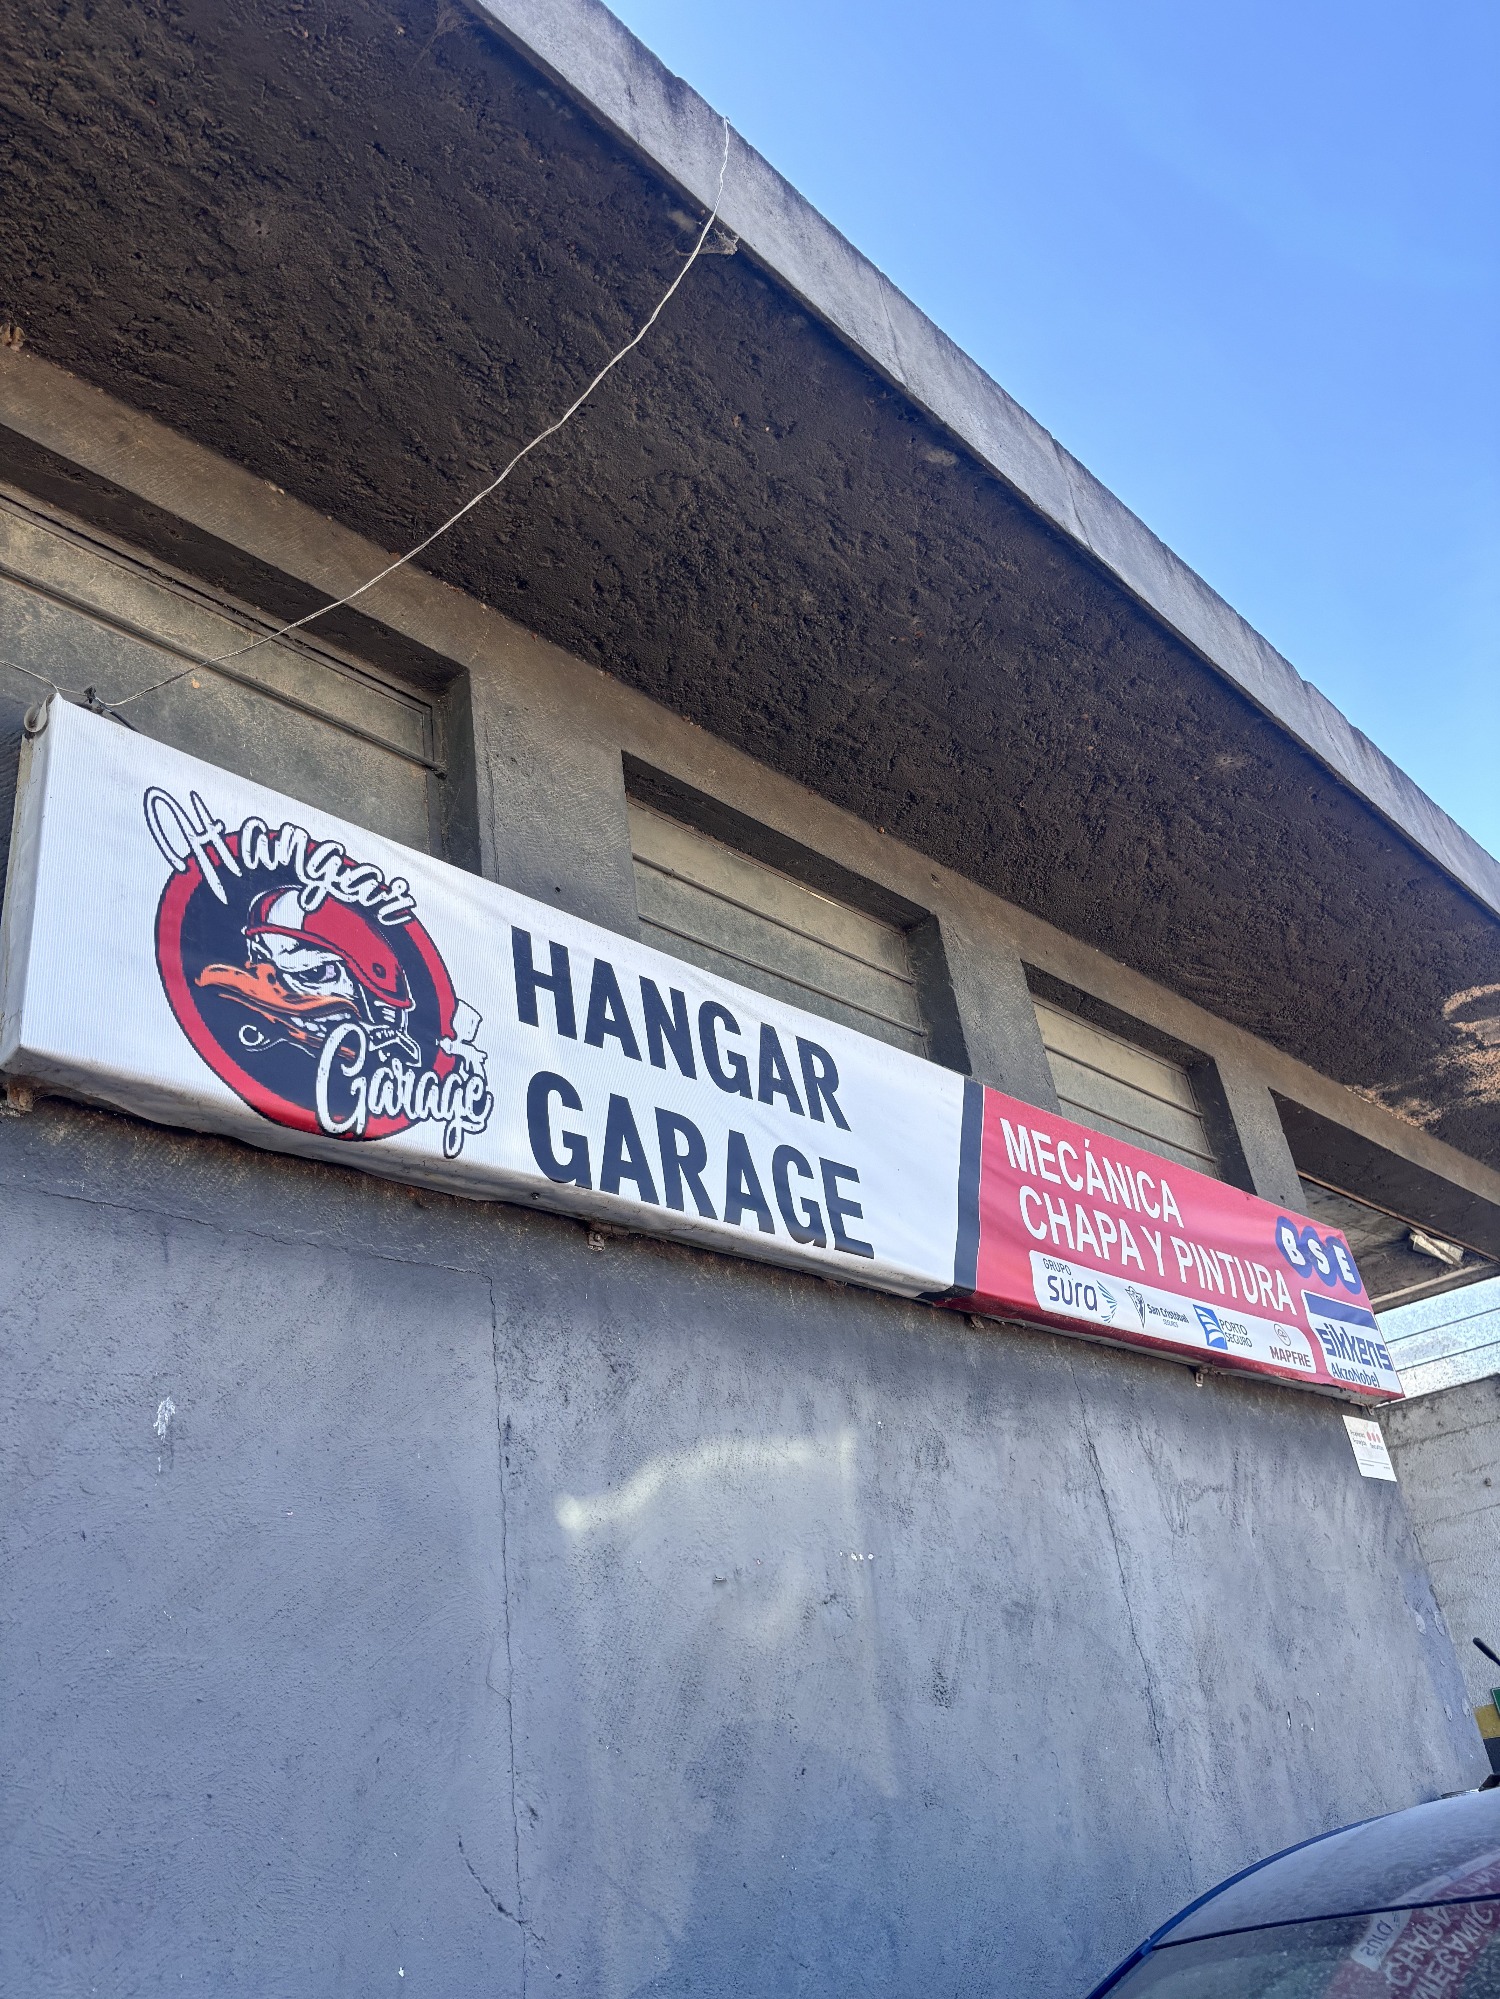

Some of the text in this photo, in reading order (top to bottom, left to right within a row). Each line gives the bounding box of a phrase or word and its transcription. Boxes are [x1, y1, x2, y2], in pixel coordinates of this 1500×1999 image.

[143, 786, 416, 926] Hangar
[511, 925, 852, 1132] HANGAR
[316, 1021, 494, 1159] Garage
[527, 1071, 874, 1260] GARAGE
[1000, 1117, 1185, 1228] MECÁNICA
[1019, 1185, 1297, 1316] CHAPA Y PINTURA
[1042, 1258, 1072, 1276] GRUPO
[1280, 1226, 1356, 1284] BSE
[1047, 1275, 1098, 1311] sura
[1147, 1303, 1161, 1316] San
[1219, 1318, 1248, 1336] PORTO
[1224, 1332, 1253, 1348] SEGURO
[1315, 1322, 1394, 1372] sikkens
[1269, 1345, 1312, 1368] MAPFRE
[1331, 1362, 1380, 1388] AkzoNobel
